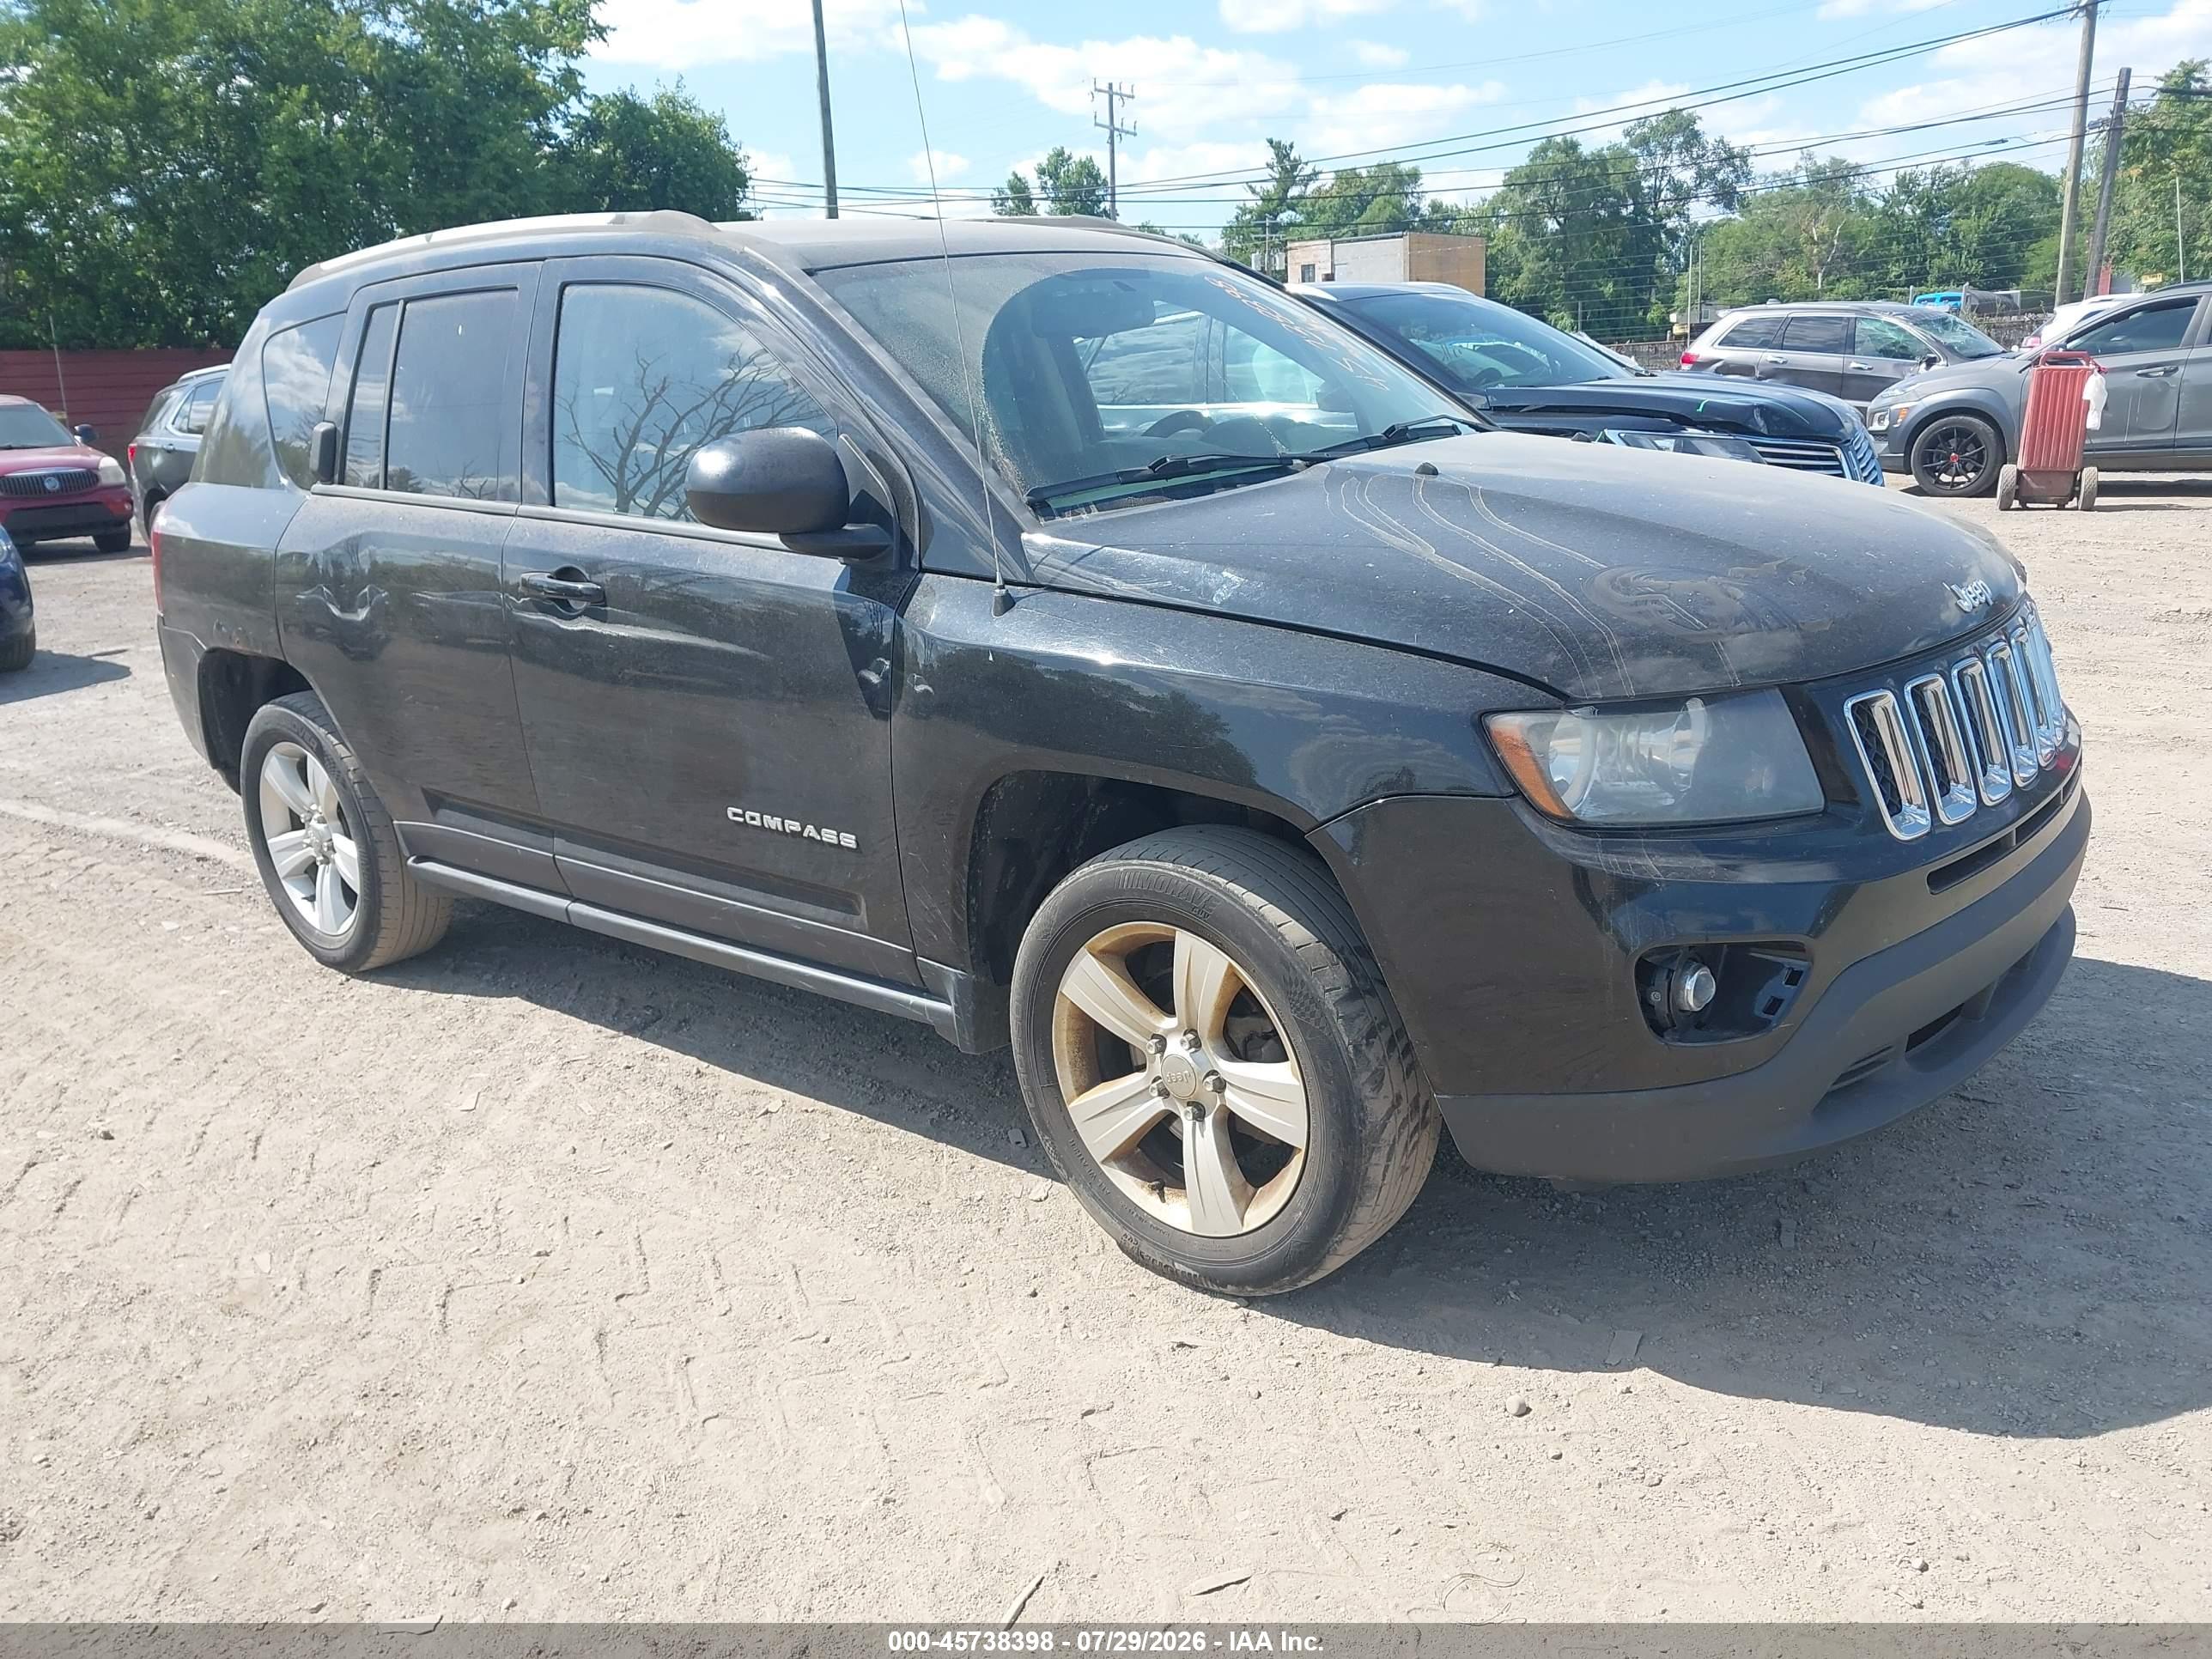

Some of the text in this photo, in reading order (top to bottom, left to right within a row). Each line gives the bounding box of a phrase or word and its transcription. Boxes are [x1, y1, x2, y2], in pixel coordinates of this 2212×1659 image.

[1949, 579, 1994, 613] Jeep
[726, 806, 858, 850] COMPASS
[1166, 1070, 1192, 1085] Jeep
